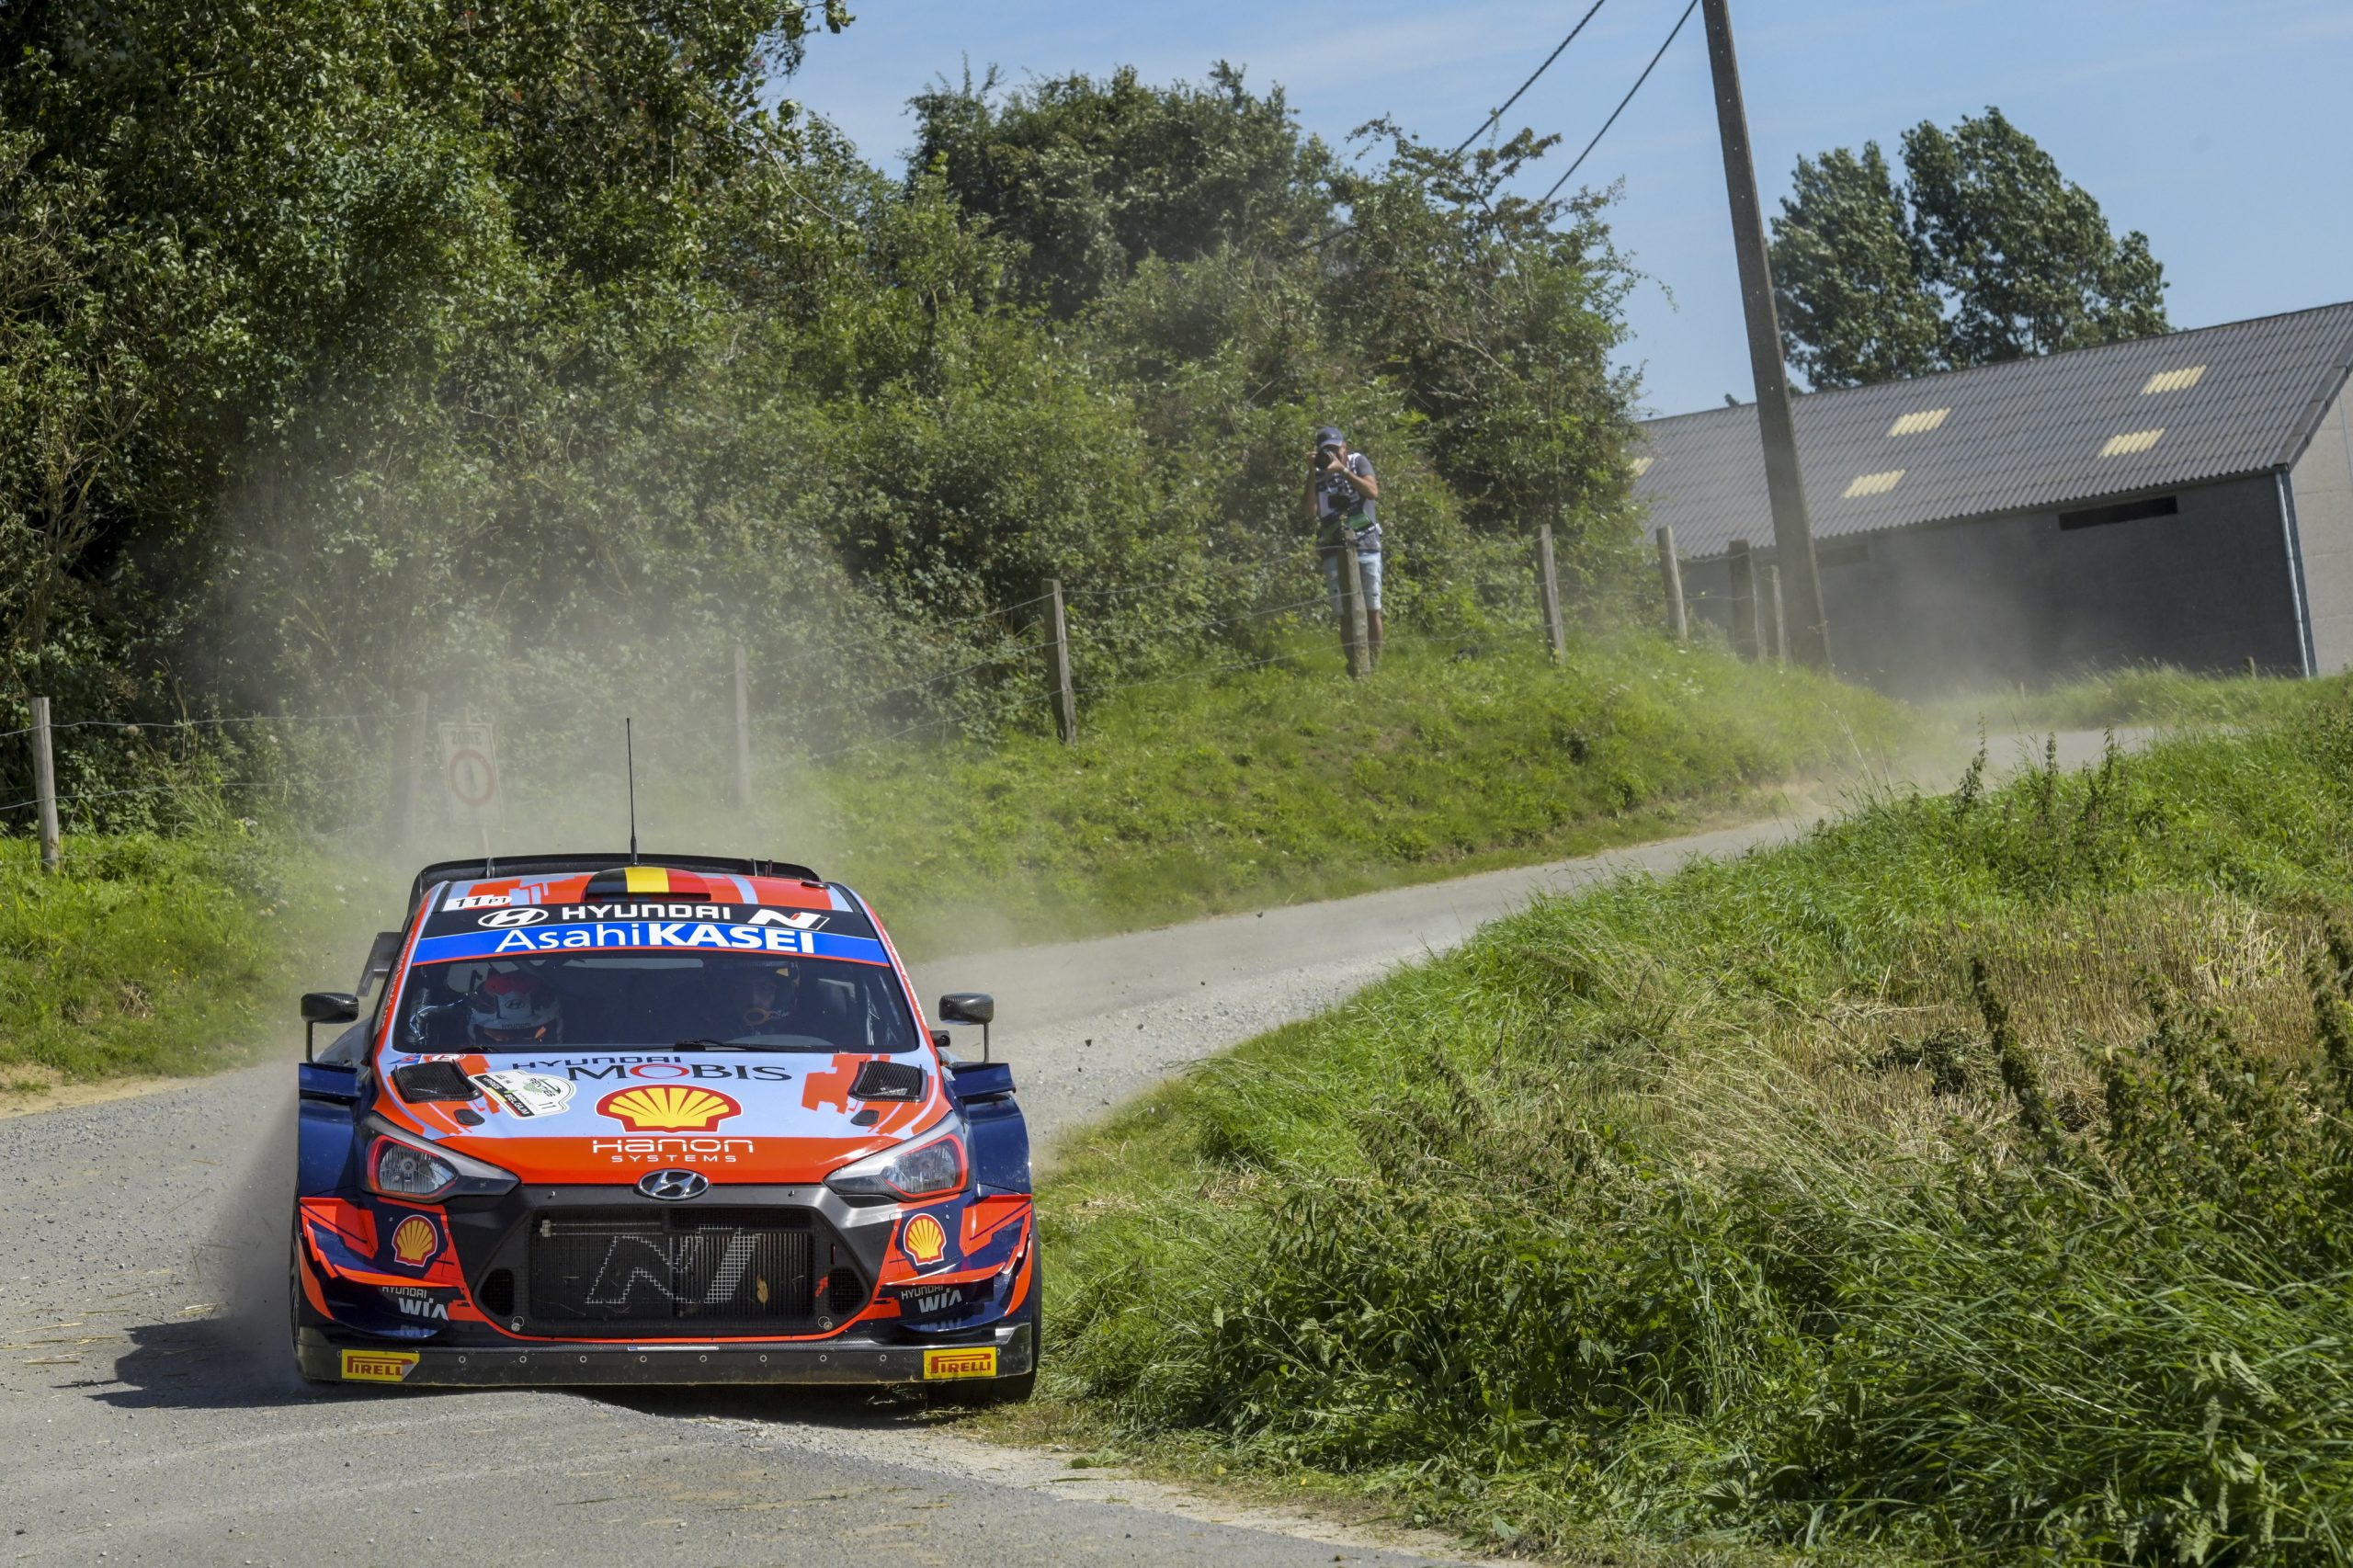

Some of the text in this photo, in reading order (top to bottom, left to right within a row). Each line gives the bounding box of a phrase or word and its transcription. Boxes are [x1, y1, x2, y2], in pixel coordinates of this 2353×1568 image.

[450, 731, 483, 745] ZONE
[456, 896, 483, 907] 11
[562, 904, 732, 920] HYUNDAI
[512, 1056, 681, 1070] HYUNDAI
[566, 1063, 792, 1082] MOBIS
[504, 1093, 530, 1115] BELGIUM
[611, 1154, 737, 1163] SYSTEMS
[381, 1286, 427, 1299] HYUNDAI
[901, 1285, 944, 1301] HYUNDAI
[347, 1355, 415, 1376] PIRELL
[930, 1353, 992, 1374] PIRELLI
